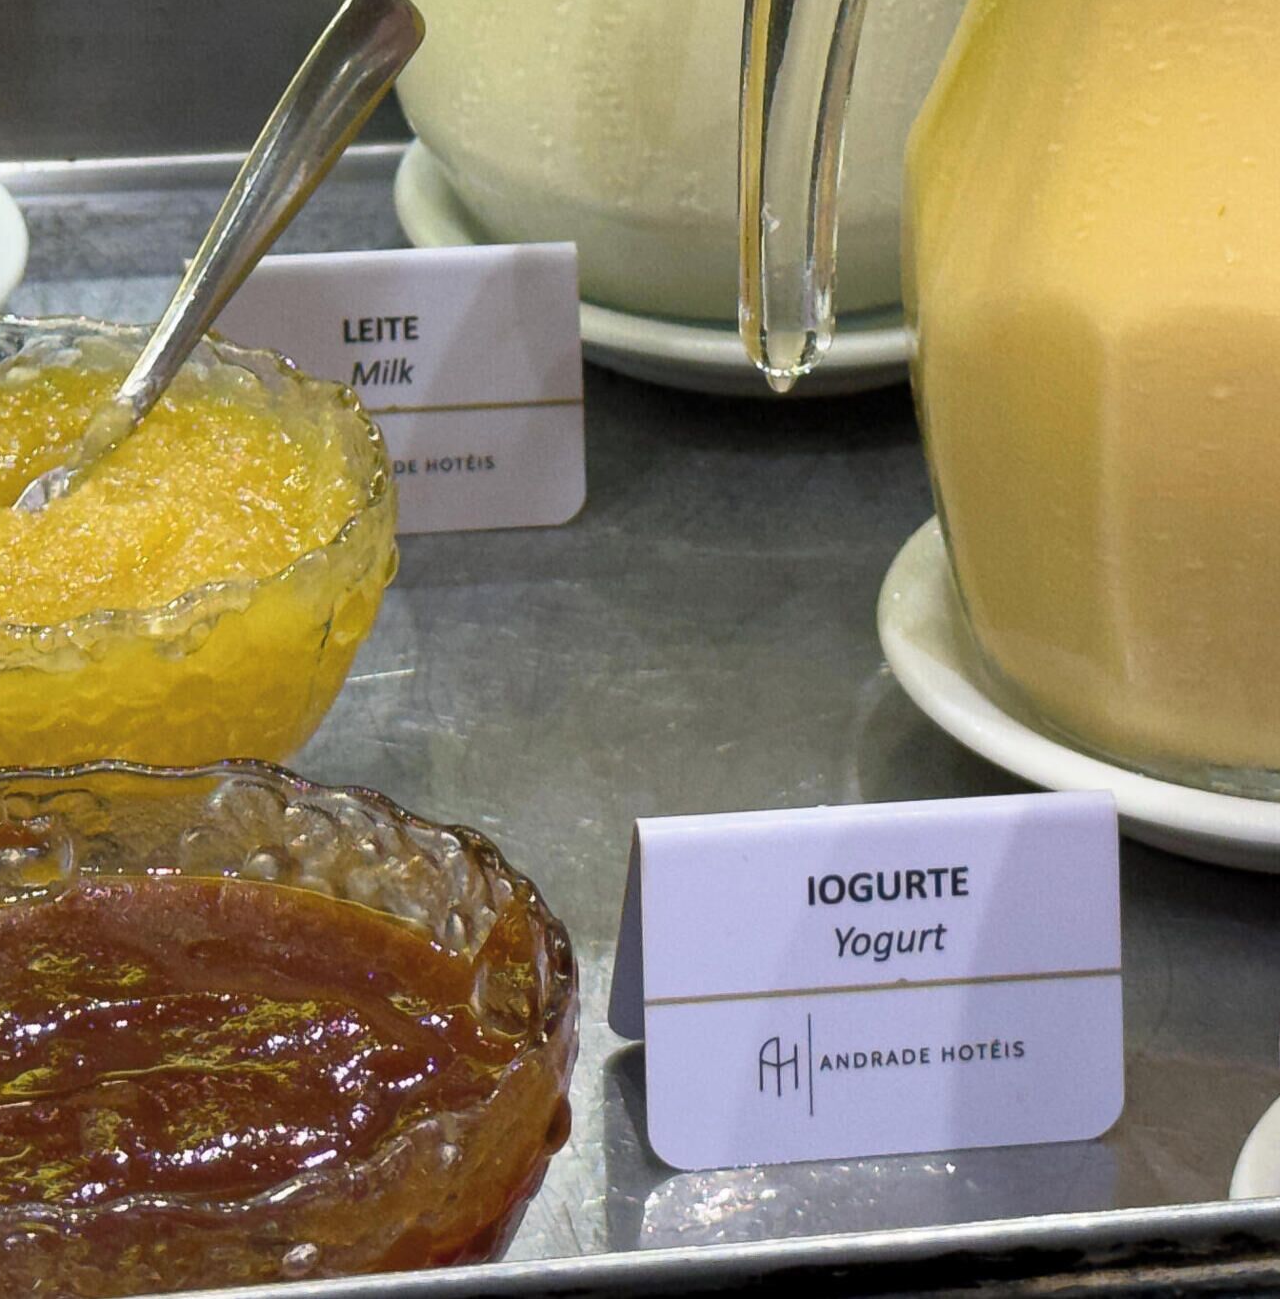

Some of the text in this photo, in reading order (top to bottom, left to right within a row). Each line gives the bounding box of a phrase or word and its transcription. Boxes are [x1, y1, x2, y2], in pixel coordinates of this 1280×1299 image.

[342, 315, 420, 345] LEITE
[350, 357, 415, 387] Milk
[424, 453, 496, 474] HOTÉIS
[807, 865, 970, 907] IOGURTE
[834, 923, 948, 963] Yogurt
[819, 1047, 931, 1072] ANDRADE
[940, 1038, 1026, 1063] HOTÉIS
